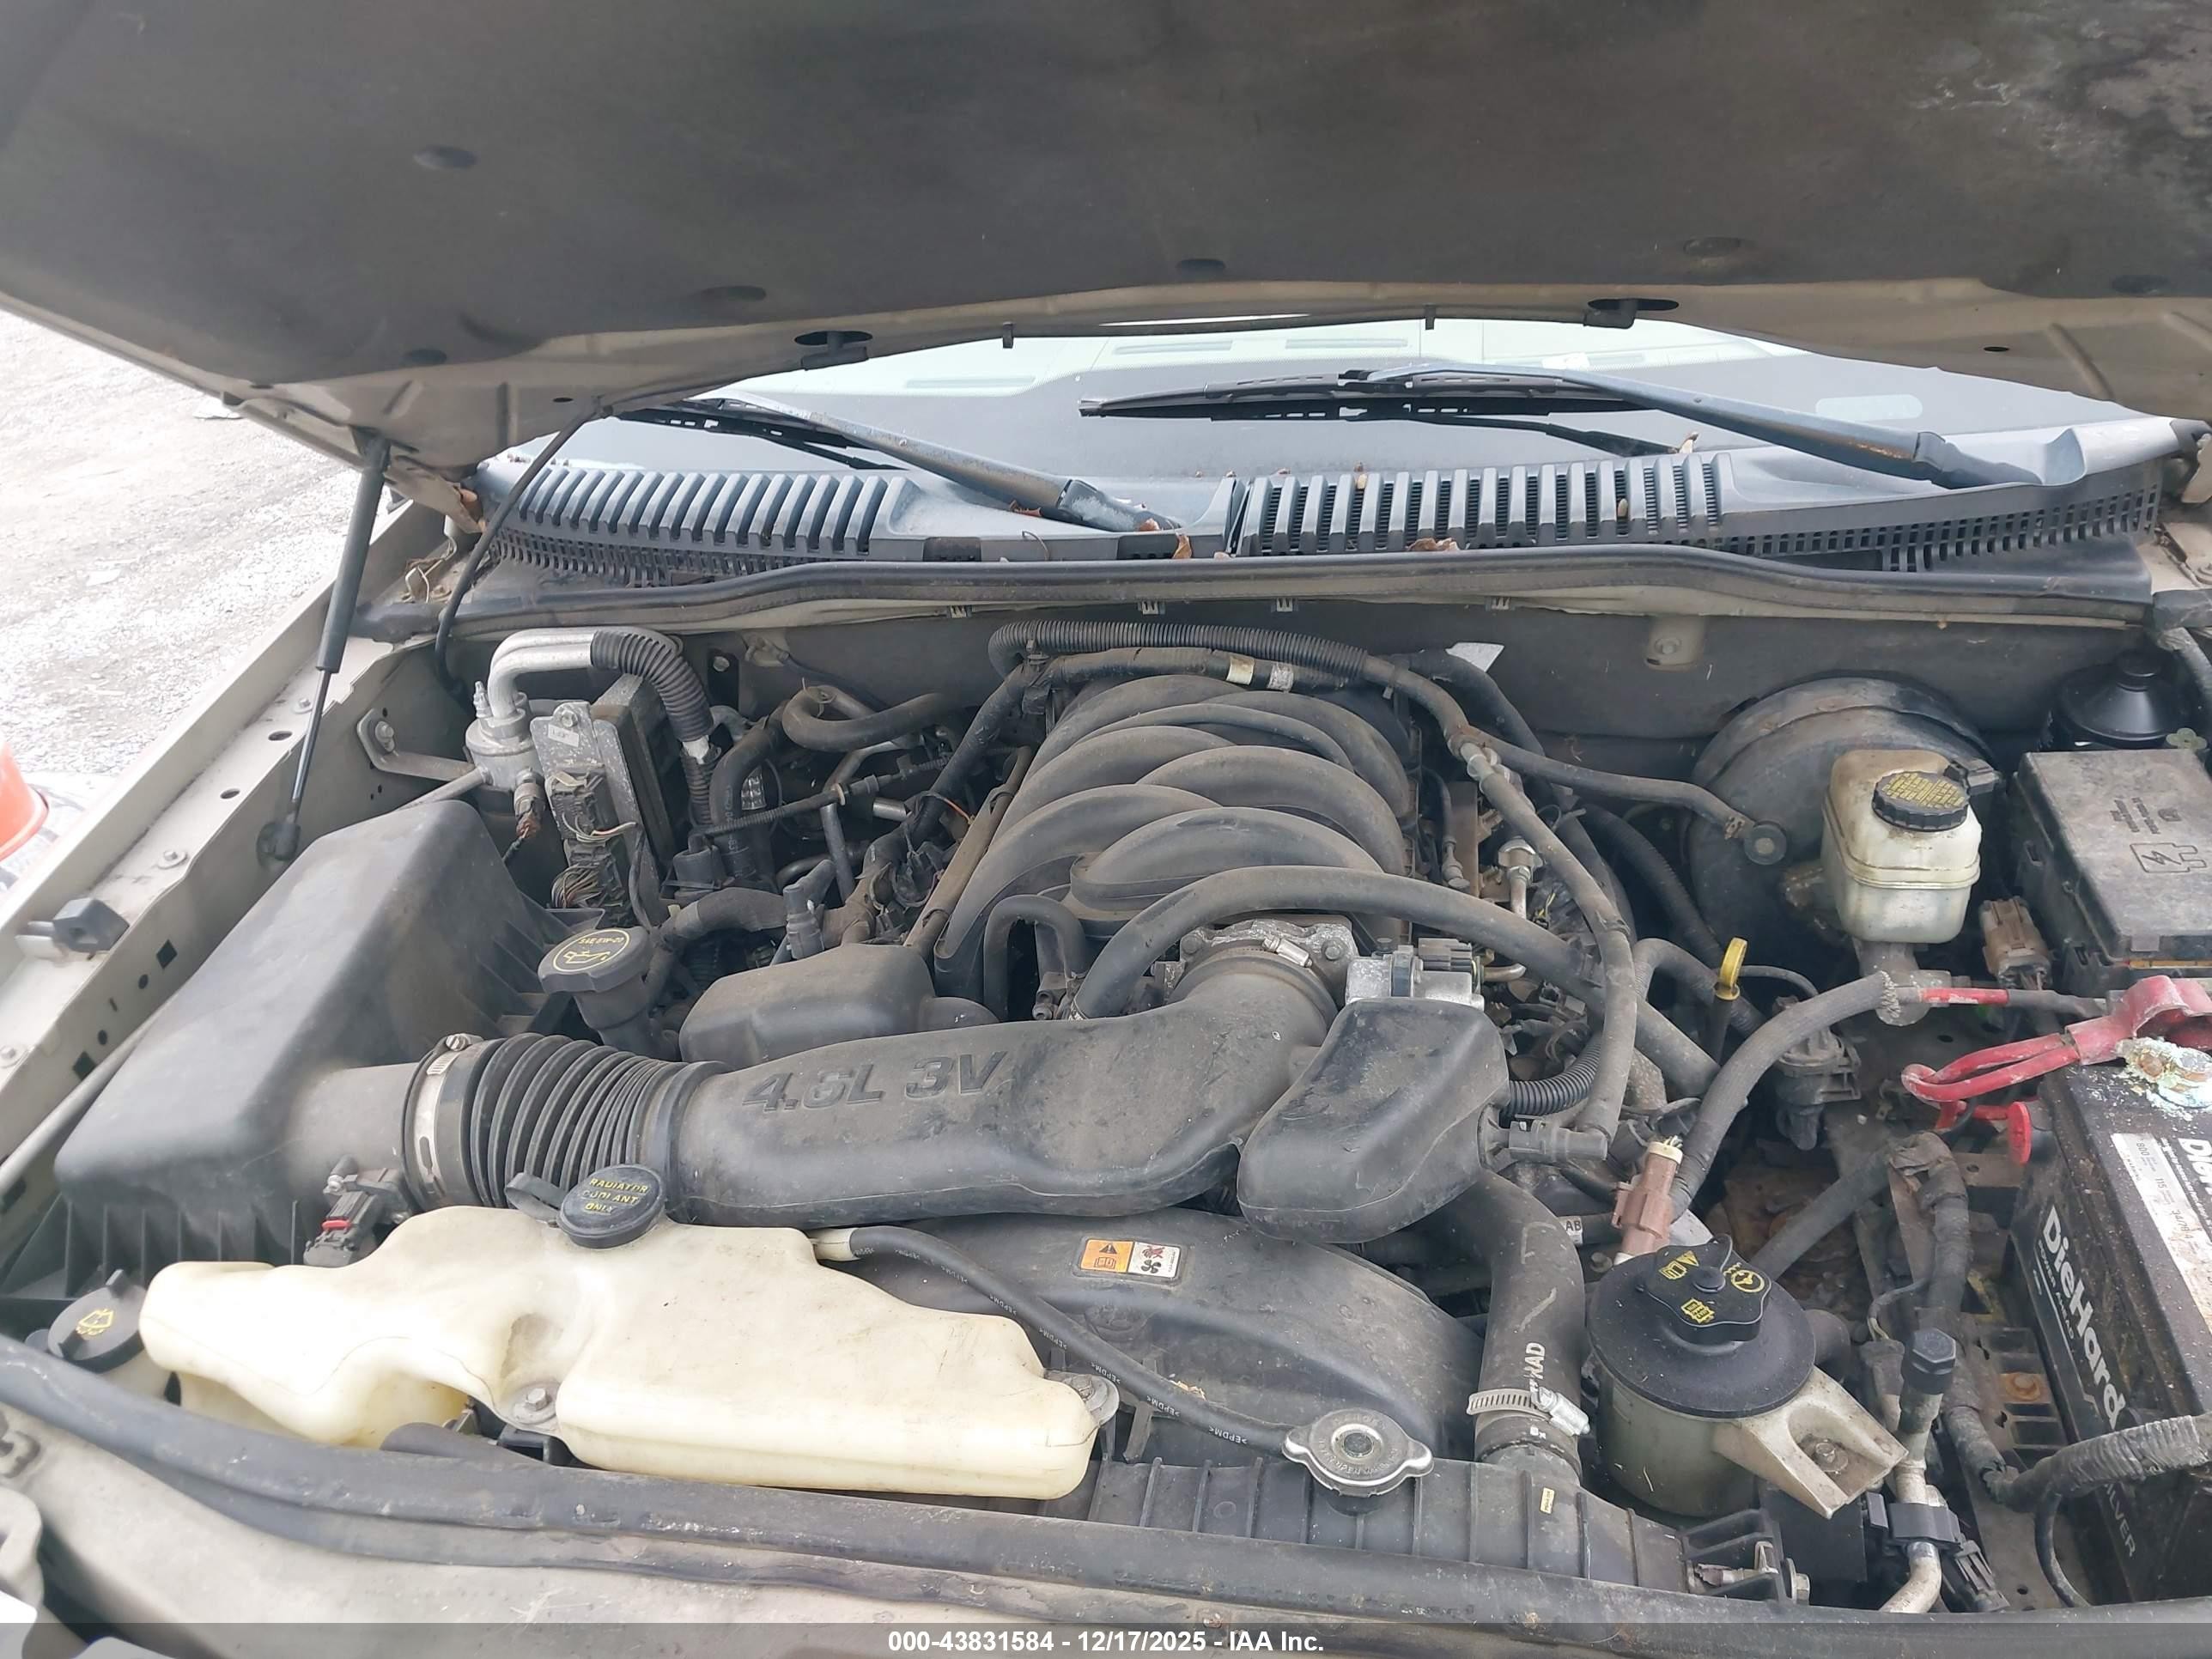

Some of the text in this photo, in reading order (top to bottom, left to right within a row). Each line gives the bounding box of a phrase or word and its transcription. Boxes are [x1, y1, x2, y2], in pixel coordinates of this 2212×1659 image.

[742, 1051, 1007, 1112] 4.6L 3V
[2136, 1141, 2150, 1157] 800
[590, 1178, 648, 1193] RADIATOR
[585, 1202, 615, 1214] ONLY
[2043, 1205, 2126, 1430] DieHard
